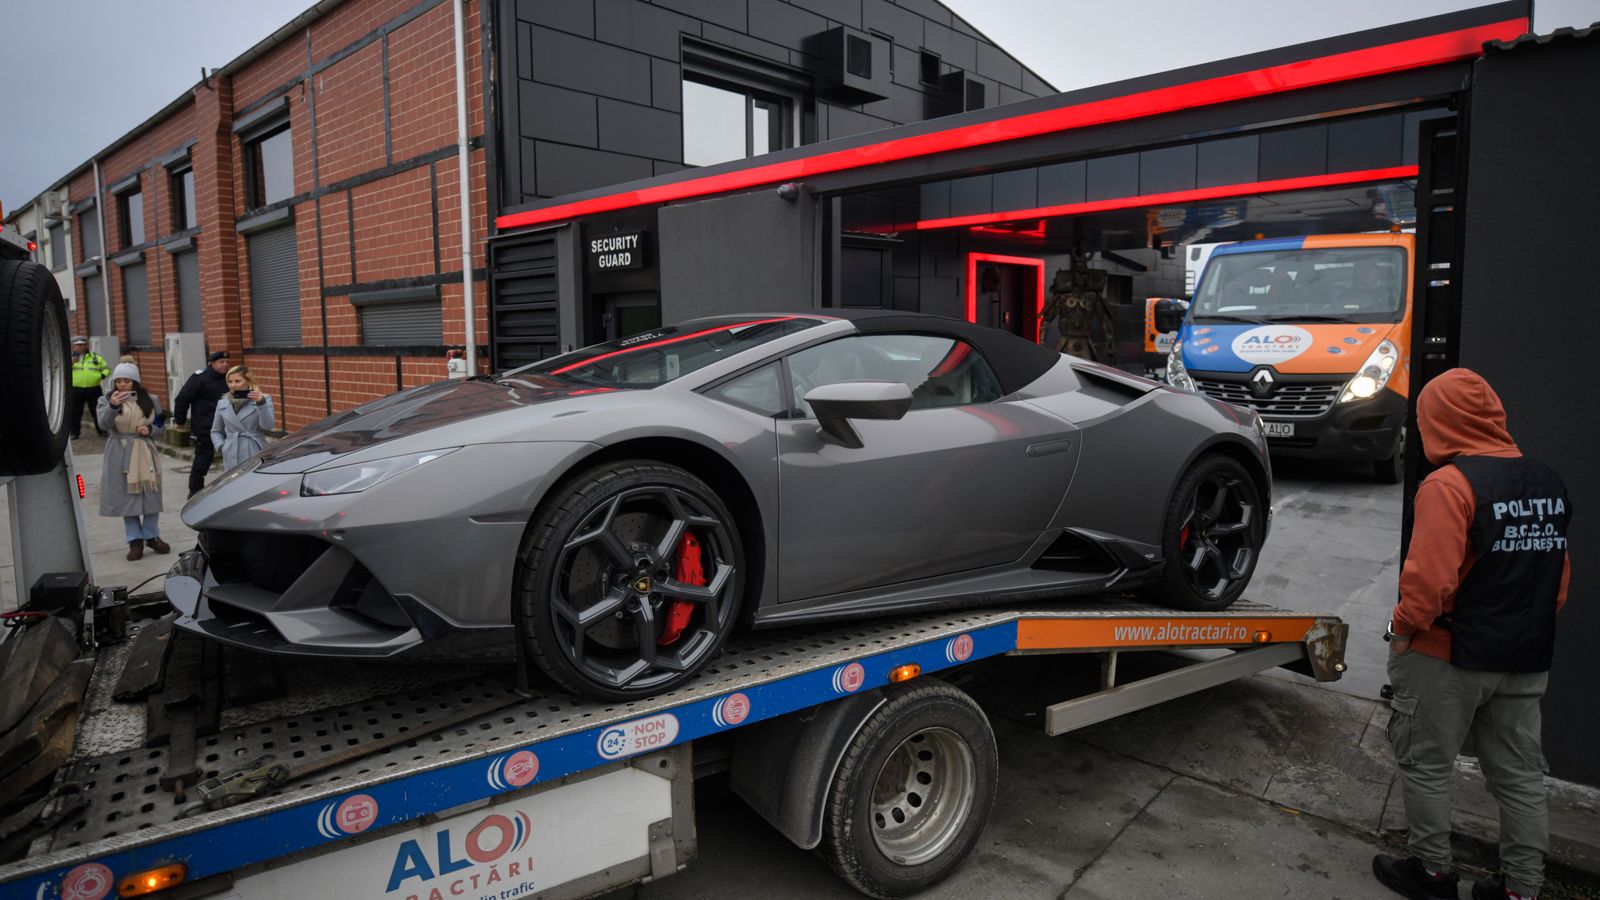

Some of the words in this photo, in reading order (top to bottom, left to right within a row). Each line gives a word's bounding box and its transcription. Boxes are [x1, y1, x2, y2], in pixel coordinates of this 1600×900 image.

[591, 234, 639, 253] SECURITY
[599, 252, 632, 268] GUARD
[1244, 335, 1293, 345] ALO
[1269, 423, 1291, 435] ALO
[1492, 497, 1565, 522] POLIȚIA
[1504, 523, 1559, 539] B.C.C.O.
[1114, 621, 1247, 641] www.alotractari.ro
[634, 719, 666, 735] NON
[607, 738, 619, 748] 24
[634, 732, 667, 749] STOP
[385, 813, 515, 894] ALO
[500, 881, 535, 900] trafic
